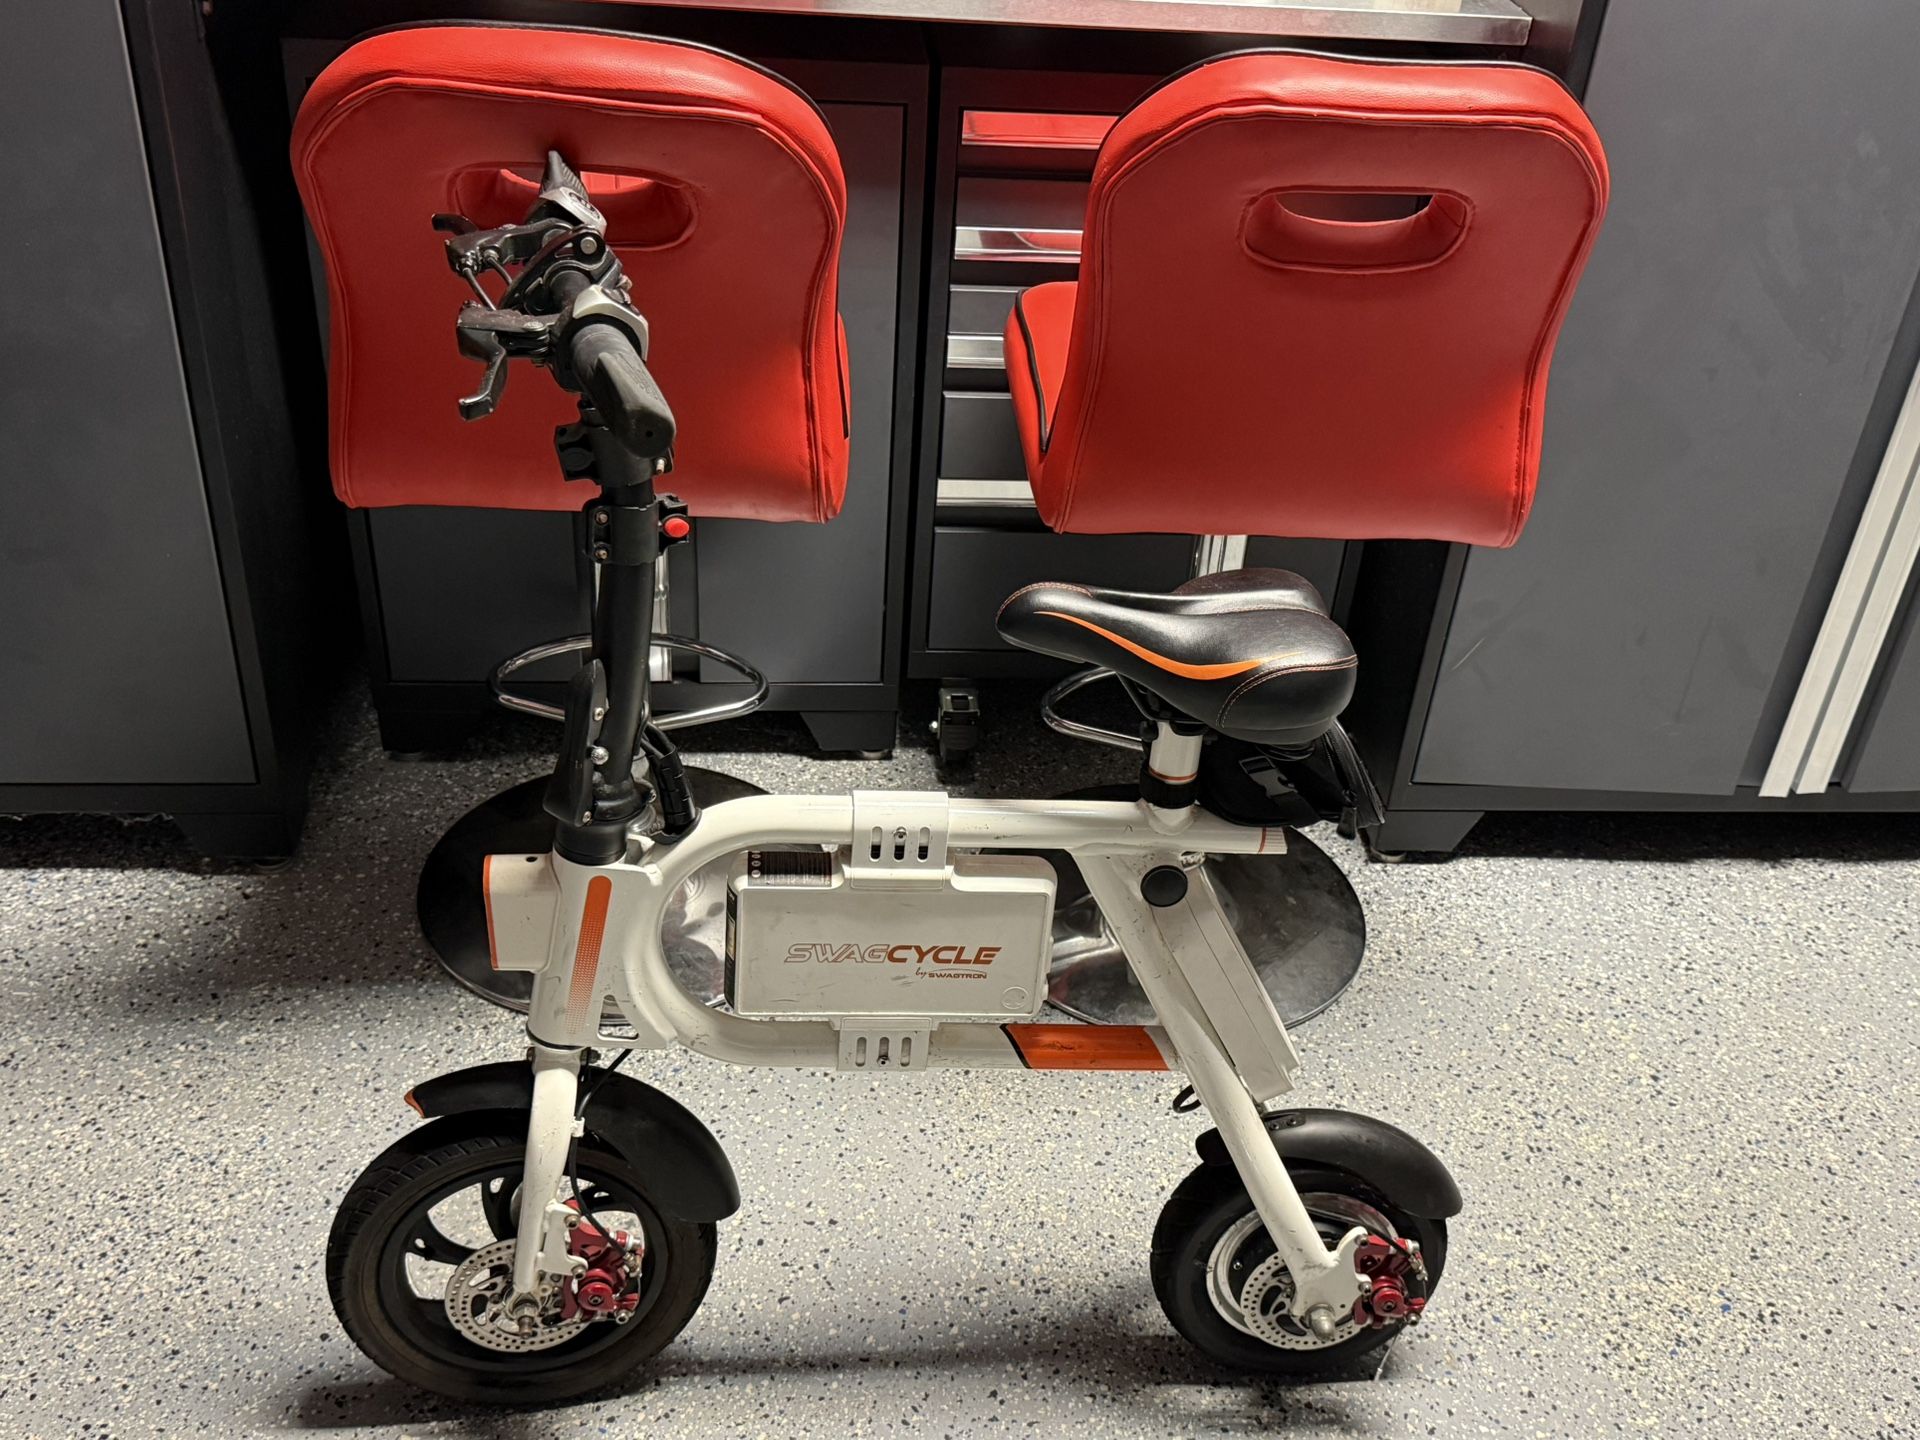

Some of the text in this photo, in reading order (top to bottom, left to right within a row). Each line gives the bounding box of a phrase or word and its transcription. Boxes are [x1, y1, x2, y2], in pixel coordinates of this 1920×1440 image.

[784, 943, 1002, 965] SWAGCYCLE
[915, 967, 987, 980] by SWAGTRON
